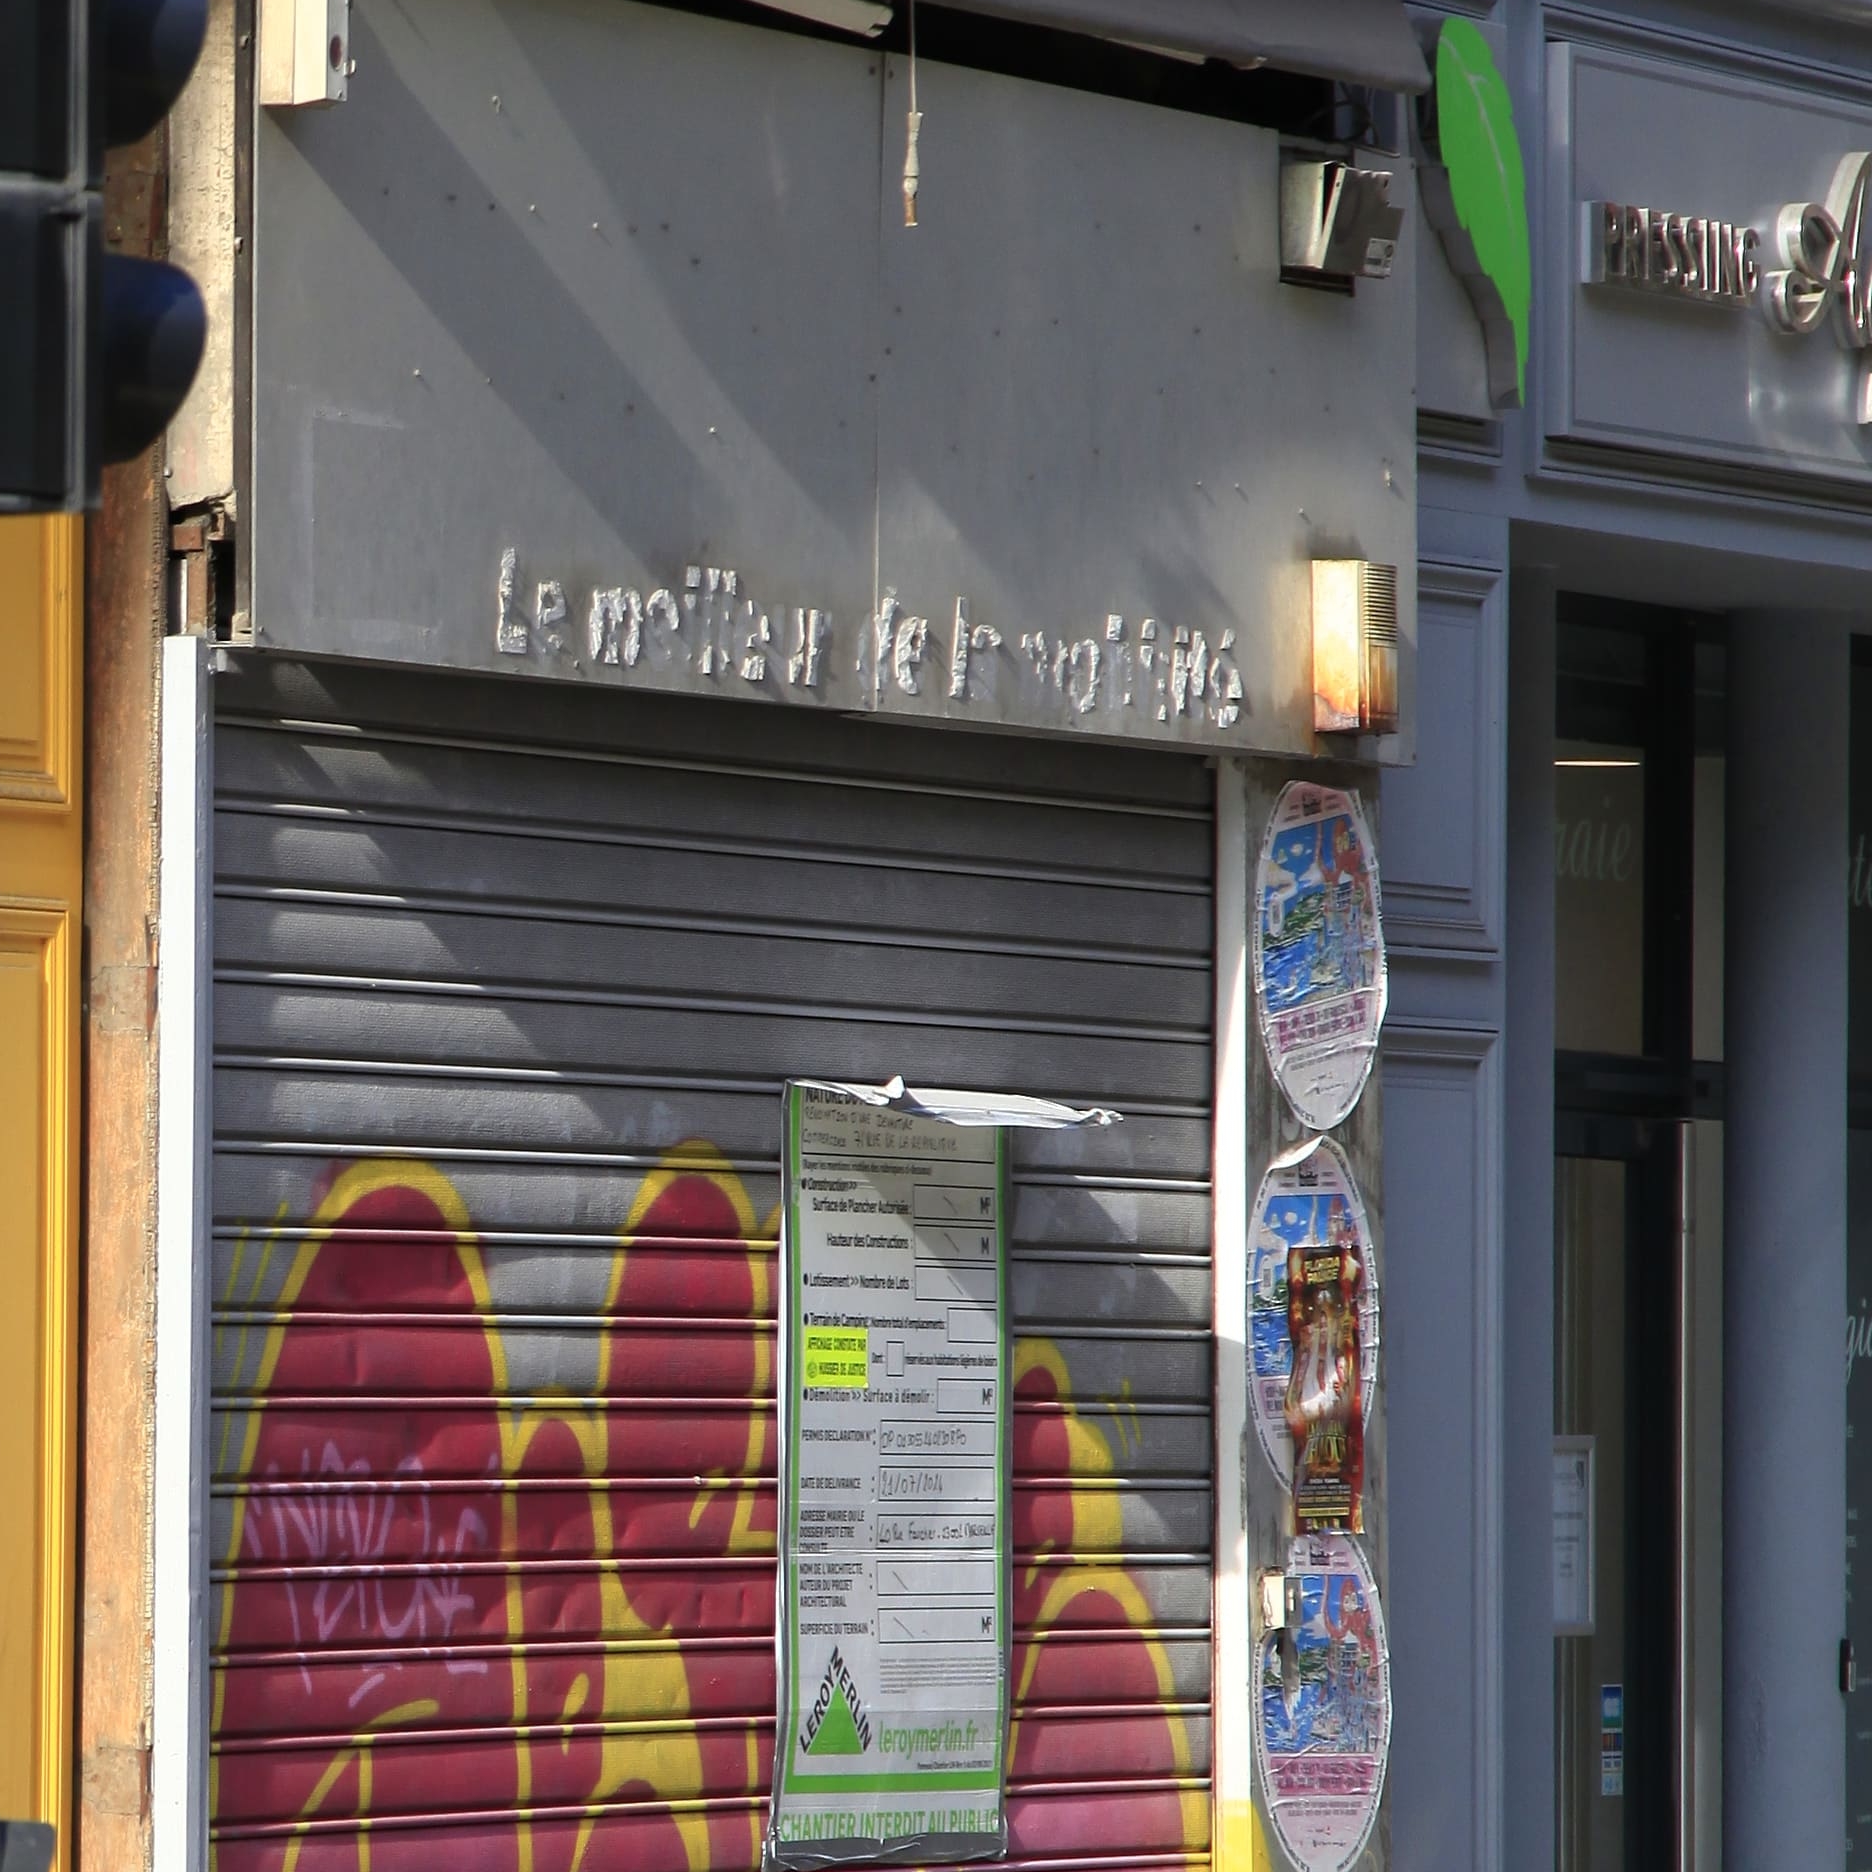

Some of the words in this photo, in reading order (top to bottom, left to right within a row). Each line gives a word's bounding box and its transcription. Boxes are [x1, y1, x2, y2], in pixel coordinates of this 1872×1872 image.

[1583, 200, 1762, 310] PRESSING
[812, 1198, 837, 1212] Surface
[839, 1198, 847, 1212] de
[848, 1198, 877, 1214] Plancher
[827, 1233, 852, 1247] Hauteur
[854, 1233, 865, 1247] des
[866, 1234, 909, 1249] Constructions
[810, 1273, 850, 1288] Lotissement
[859, 1276, 886, 1290] Nombre
[887, 1276, 895, 1289] de
[896, 1276, 910, 1290] Lots
[810, 1312, 832, 1326] Terrain
[863, 1389, 893, 1404] Surface
[901, 1388, 931, 1404] démolir
[801, 1477, 816, 1490] DATE
[831, 1645, 872, 1751] MERLIN
[800, 1664, 836, 1754] LEROY
[879, 1719, 978, 1761] leroymerlin.fr
[780, 1812, 859, 1841] CHANTIER
[860, 1811, 926, 1840] INTERDIT
[928, 1810, 947, 1835] AU
[949, 1808, 1000, 1834] PUBLIC
